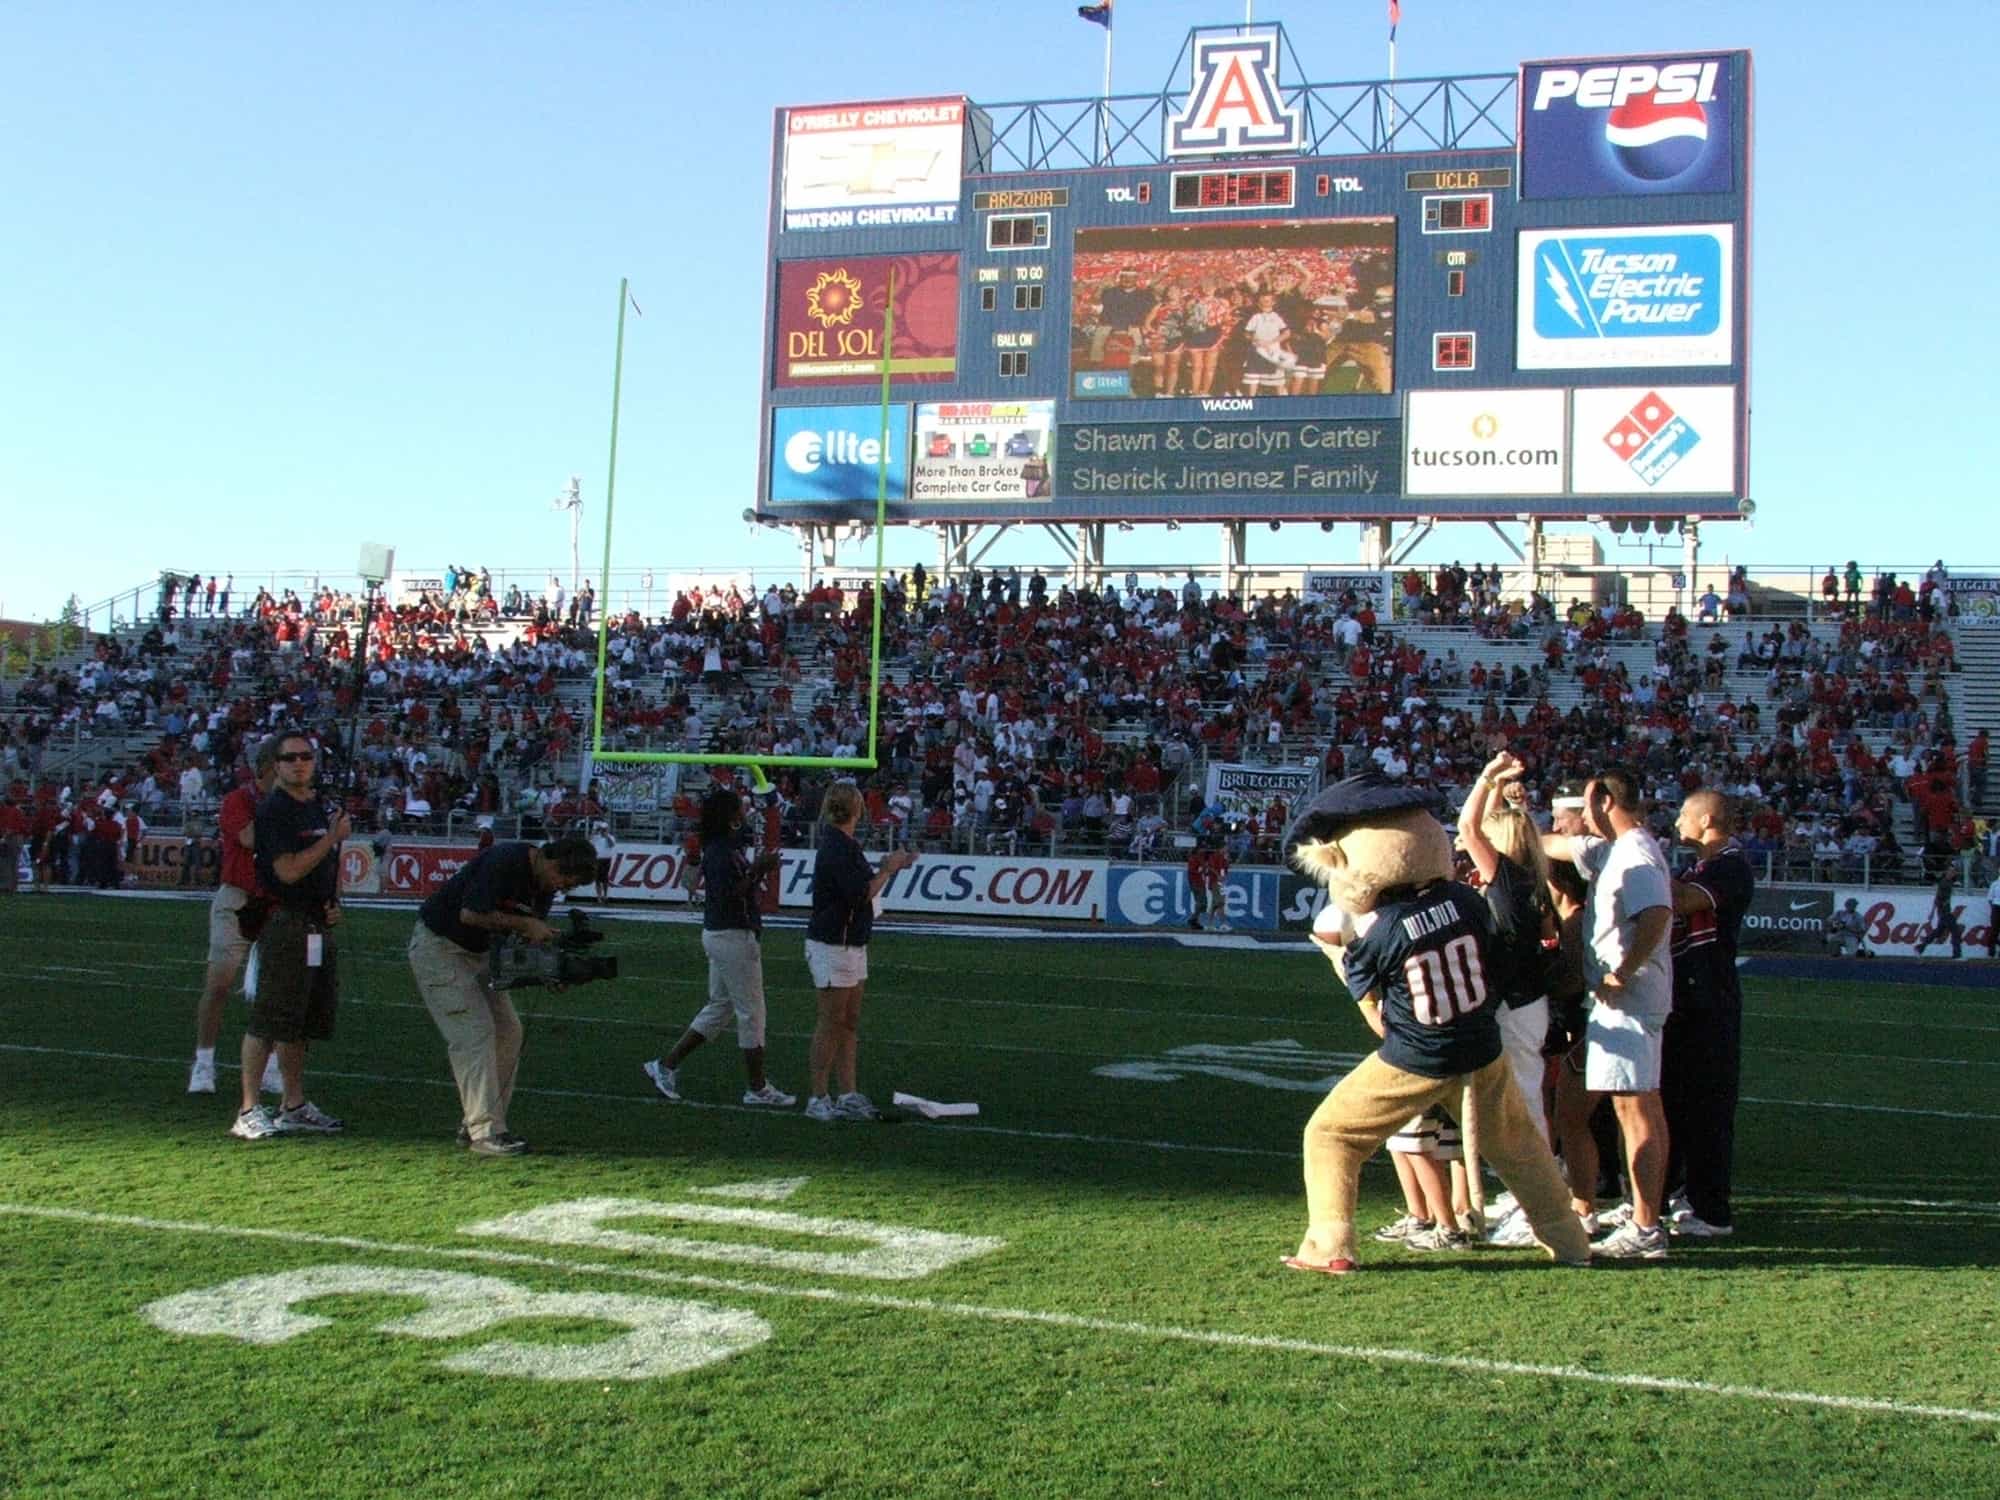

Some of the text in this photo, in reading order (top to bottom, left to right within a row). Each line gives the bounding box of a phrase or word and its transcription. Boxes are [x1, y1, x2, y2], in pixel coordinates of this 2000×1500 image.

[1533, 62, 1719, 110] PEPSI
[864, 104, 960, 126] CHEVROLET
[1333, 177, 1363, 193] TOL
[1435, 171, 1480, 190] UCLA
[988, 191, 1054, 209] ARIZONA
[1106, 187, 1135, 203] TOL
[786, 205, 957, 230] WATSON CHEVROLET
[1579, 248, 1677, 275] Tucson
[1016, 267, 1043, 281] TO GO
[1589, 273, 1704, 299] Electric
[1600, 298, 1703, 324] Power
[788, 328, 878, 358] DEL SOL
[996, 333, 1033, 347] BALL ON
[1202, 399, 1253, 412] VIACOM
[799, 430, 892, 468] alltel
[1073, 424, 1382, 456] Shawn & Carolyn Carter
[1411, 447, 1558, 466] tucson.com
[916, 464, 1019, 478] More Than Brakes
[1072, 463, 1379, 494] Sherick Jimenez Family
[915, 480, 1021, 495] Complete Car Care
[1402, 900, 1461, 941] WILBUR
[1403, 934, 1487, 1026] 00
